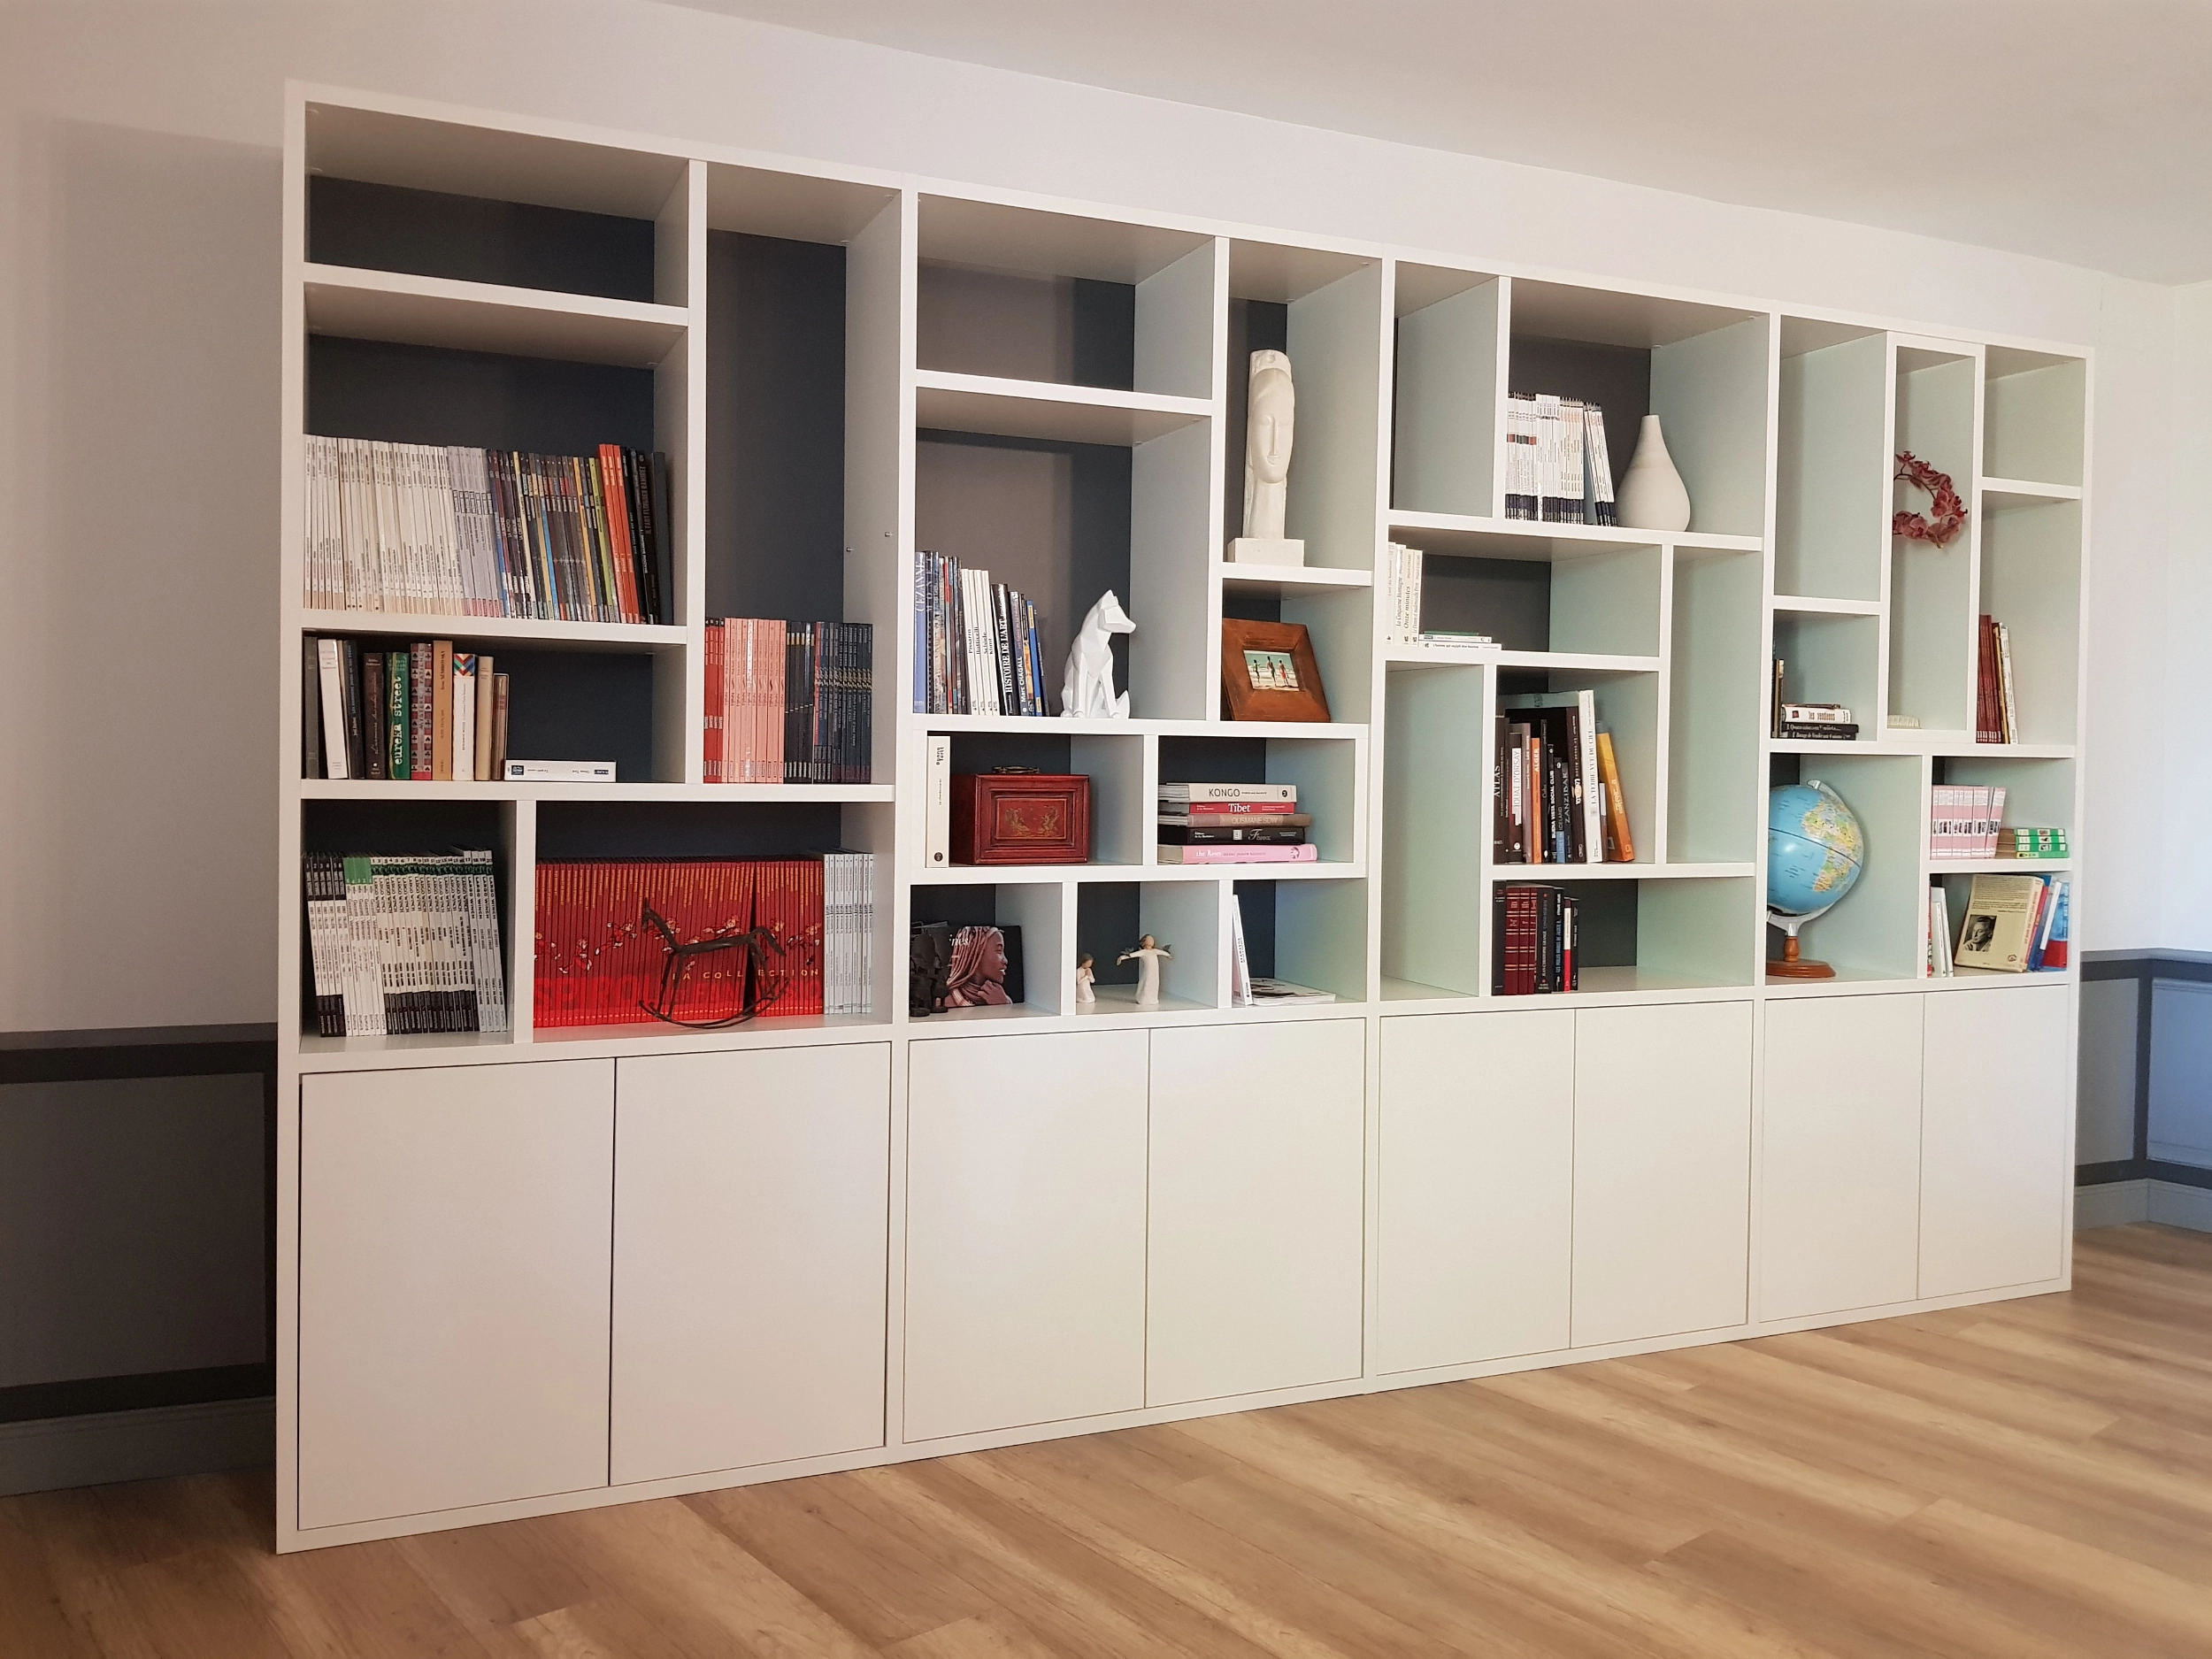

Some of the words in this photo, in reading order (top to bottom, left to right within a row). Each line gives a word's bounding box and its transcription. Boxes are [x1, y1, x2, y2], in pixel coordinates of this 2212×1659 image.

[999, 618, 1009, 641] L'ART
[1001, 642, 1010, 654] DE
[1002, 655, 1013, 693] HISTOIRE
[392, 676, 402, 717] street
[394, 724, 403, 765] eureka
[1588, 745, 1594, 756] DU
[1209, 788, 1240, 797] KONGO
[1562, 772, 1571, 824] ZANZIBAR
[1591, 794, 1596, 804] LA
[1228, 803, 1251, 813] Tibet
[703, 968, 818, 979] COLLECTION
